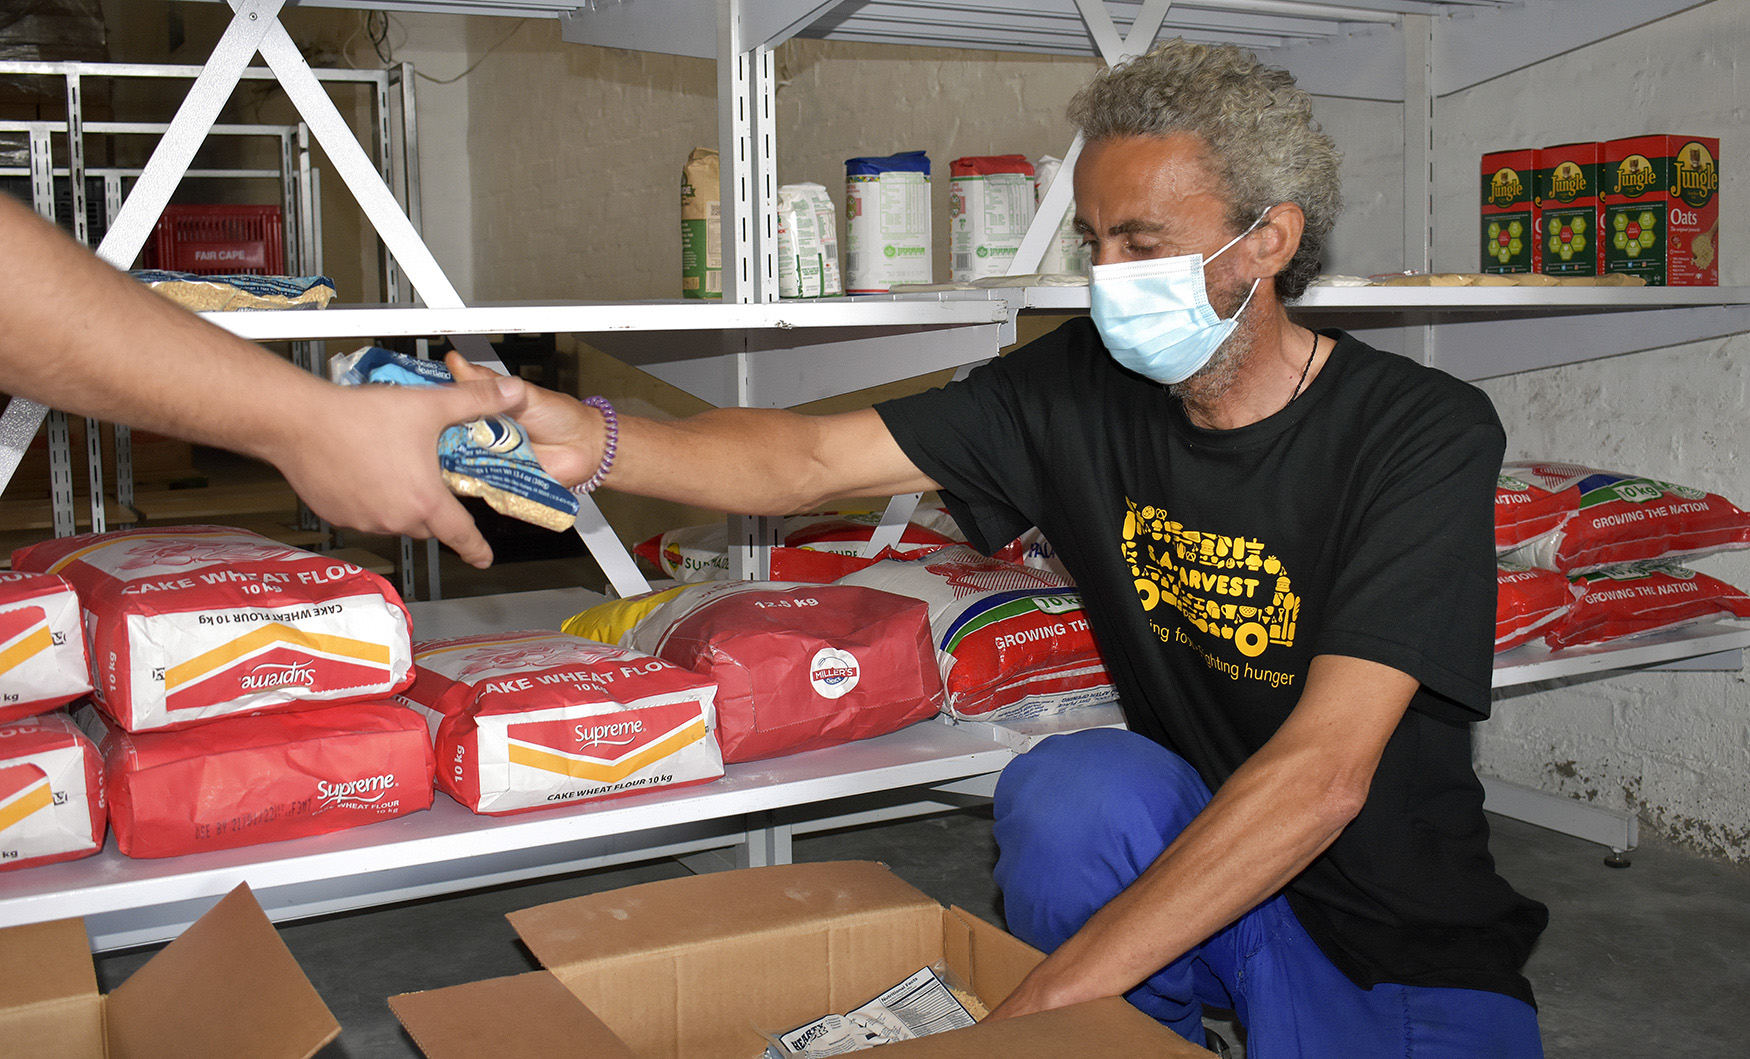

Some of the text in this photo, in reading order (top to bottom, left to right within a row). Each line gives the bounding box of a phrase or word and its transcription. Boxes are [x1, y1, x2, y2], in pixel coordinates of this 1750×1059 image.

[1488, 179, 1523, 203] Jungle
[1548, 172, 1587, 198] Jungle
[1613, 166, 1657, 193] Jungle
[1669, 161, 1718, 198] Jungle
[1670, 208, 1698, 225] Oats
[195, 250, 245, 261] FAIR CAPE
[1637, 484, 1656, 498] kg
[1593, 502, 1709, 529] GROWING THE NATION
[121, 564, 363, 595] CAKE WHEAT FLOU
[241, 584, 260, 595] 10
[1178, 566, 1260, 598] ARVEST
[755, 597, 819, 610] 12.5 kg
[1585, 589, 1635, 604] GROWING
[1657, 582, 1698, 596] NATION
[199, 604, 343, 625] CAKE WHEAT FLOUR 10 kg
[995, 619, 1090, 650] GROWING TH
[109, 652, 117, 692] 10 kg
[241, 660, 316, 690] Supreme
[535, 670, 614, 686] WHEAT
[815, 668, 853, 679] MILLER'S
[1244, 662, 1295, 688] hunger
[574, 683, 589, 691] 10
[575, 719, 643, 749] Supreme
[455, 745, 465, 782] 10 kg
[317, 773, 395, 805] Supreme
[547, 774, 673, 801] CAKE WHEAT FLOUR 10 kg
[371, 800, 400, 809] FLOUR
[216, 821, 228, 836] BY
